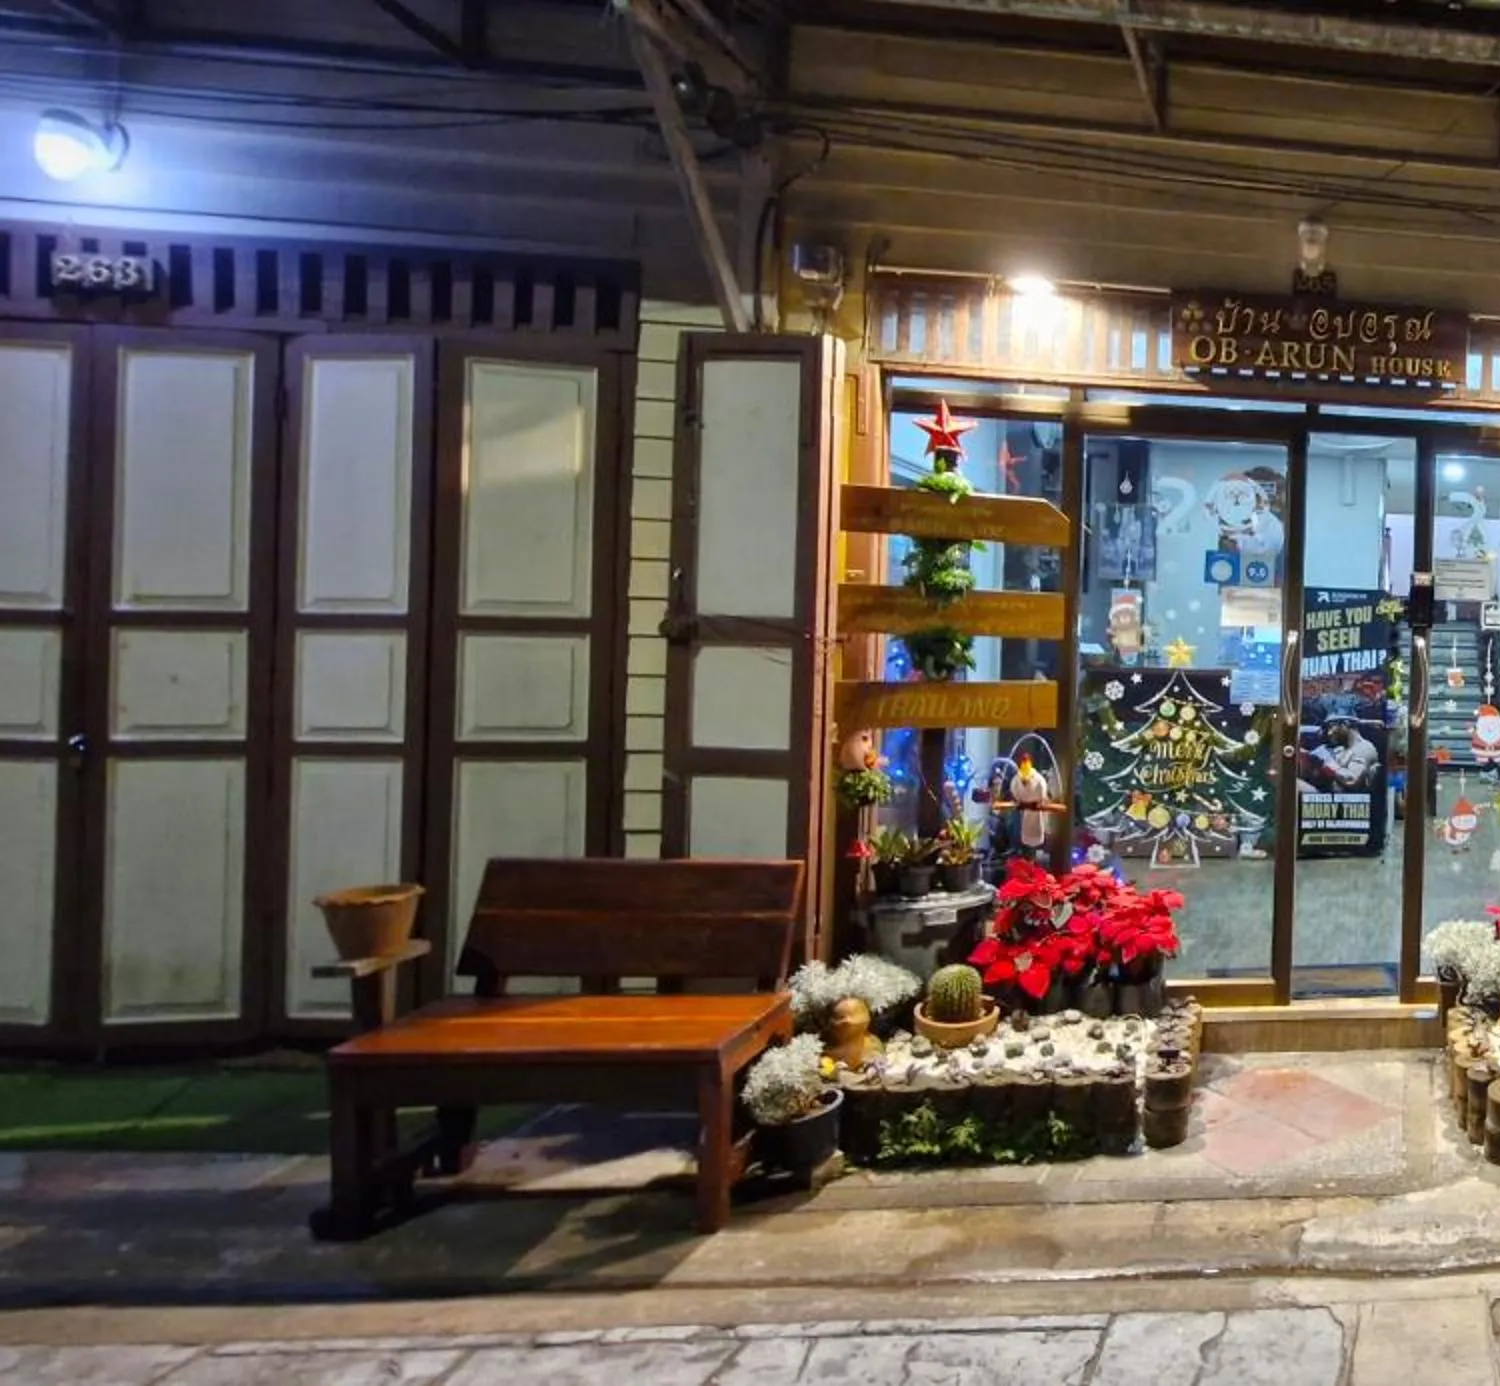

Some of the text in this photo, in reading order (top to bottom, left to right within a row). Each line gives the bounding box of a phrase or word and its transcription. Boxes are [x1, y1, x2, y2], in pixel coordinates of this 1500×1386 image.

[56, 254, 140, 287] 263
[1370, 355, 1452, 378] HOUSE
[1306, 605, 1372, 630] HAVE YOU
[1317, 627, 1360, 652] SEEN
[1341, 649, 1386, 673] THAI?
